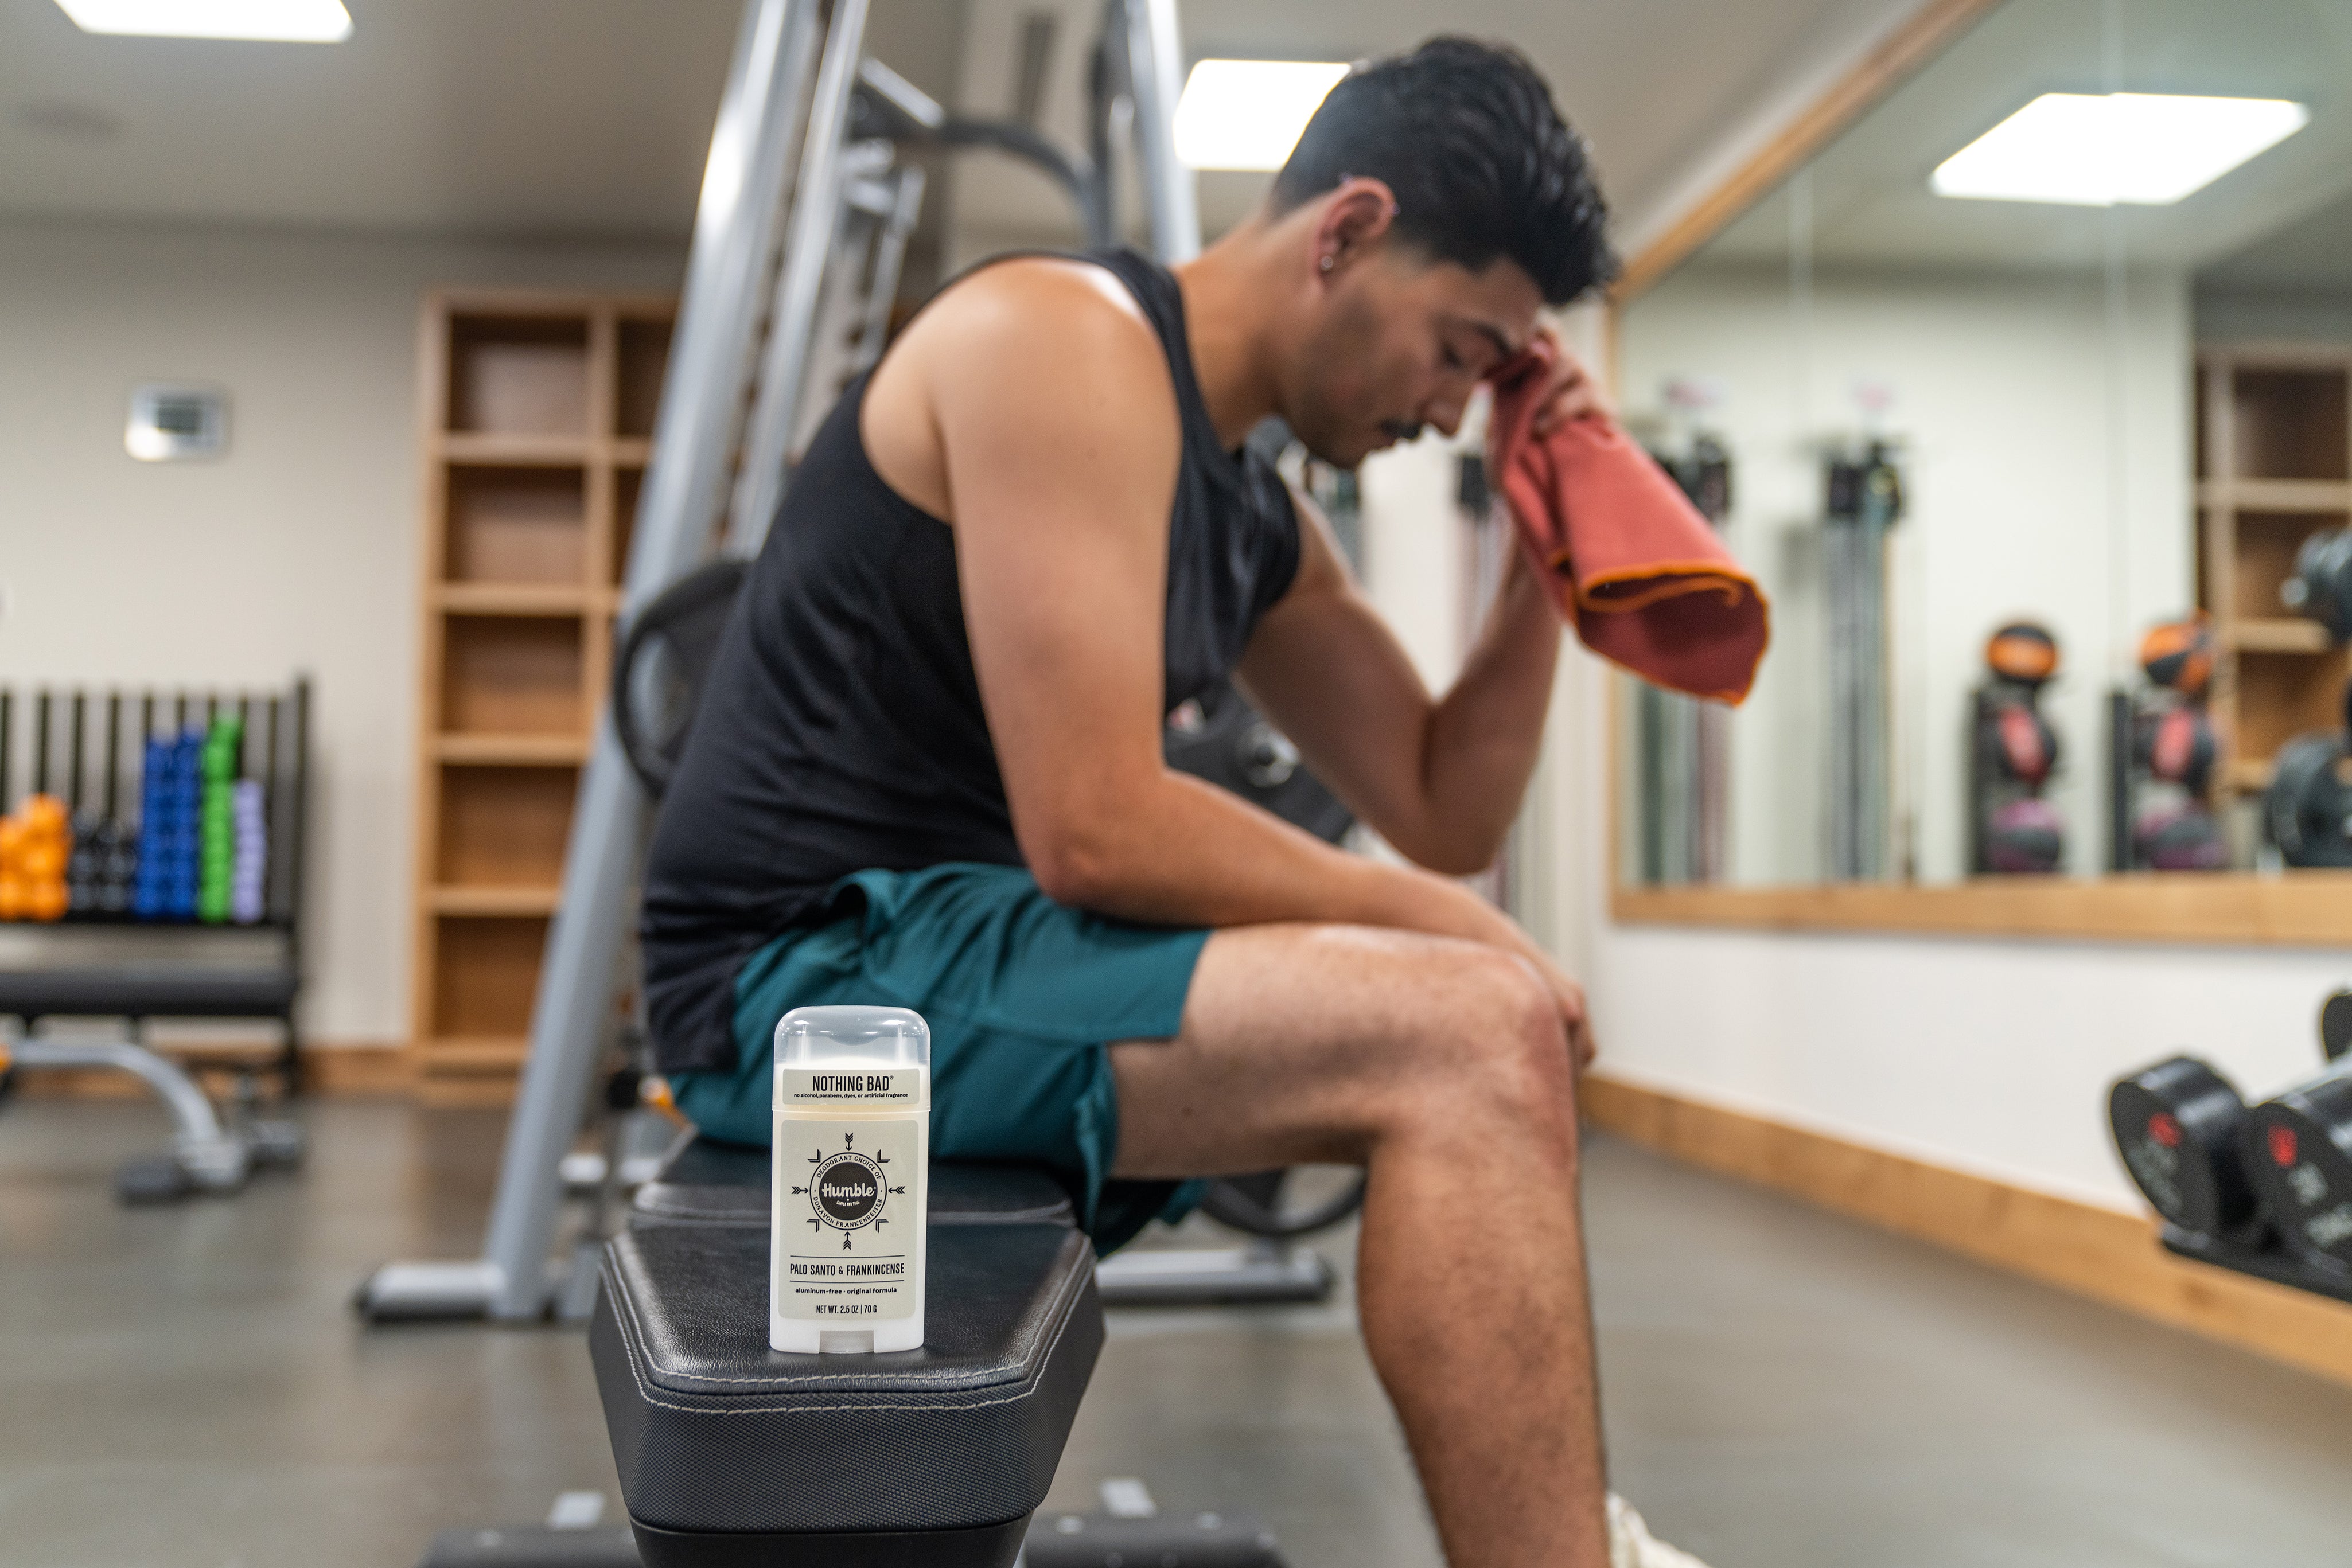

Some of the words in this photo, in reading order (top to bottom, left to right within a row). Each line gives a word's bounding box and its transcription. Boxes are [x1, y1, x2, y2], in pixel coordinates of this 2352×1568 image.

[812, 1076, 863, 1091] NOTHING
[816, 1155, 852, 1179] DEODORANT
[854, 1156, 876, 1172] CHOICE
[875, 1171, 882, 1180] OF
[813, 1196, 835, 1224] DONAVON
[835, 1198, 883, 1228] FRANKENREITER
[790, 1263, 808, 1275] PALO
[810, 1264, 835, 1276] SANTO
[847, 1263, 904, 1276] FRANKINCENSE
[816, 1305, 827, 1313] NET
[828, 1305, 838, 1313] WT.
[840, 1305, 850, 1313] 2.5
[851, 1305, 858, 1313] OZ
[873, 1305, 877, 1313] G
